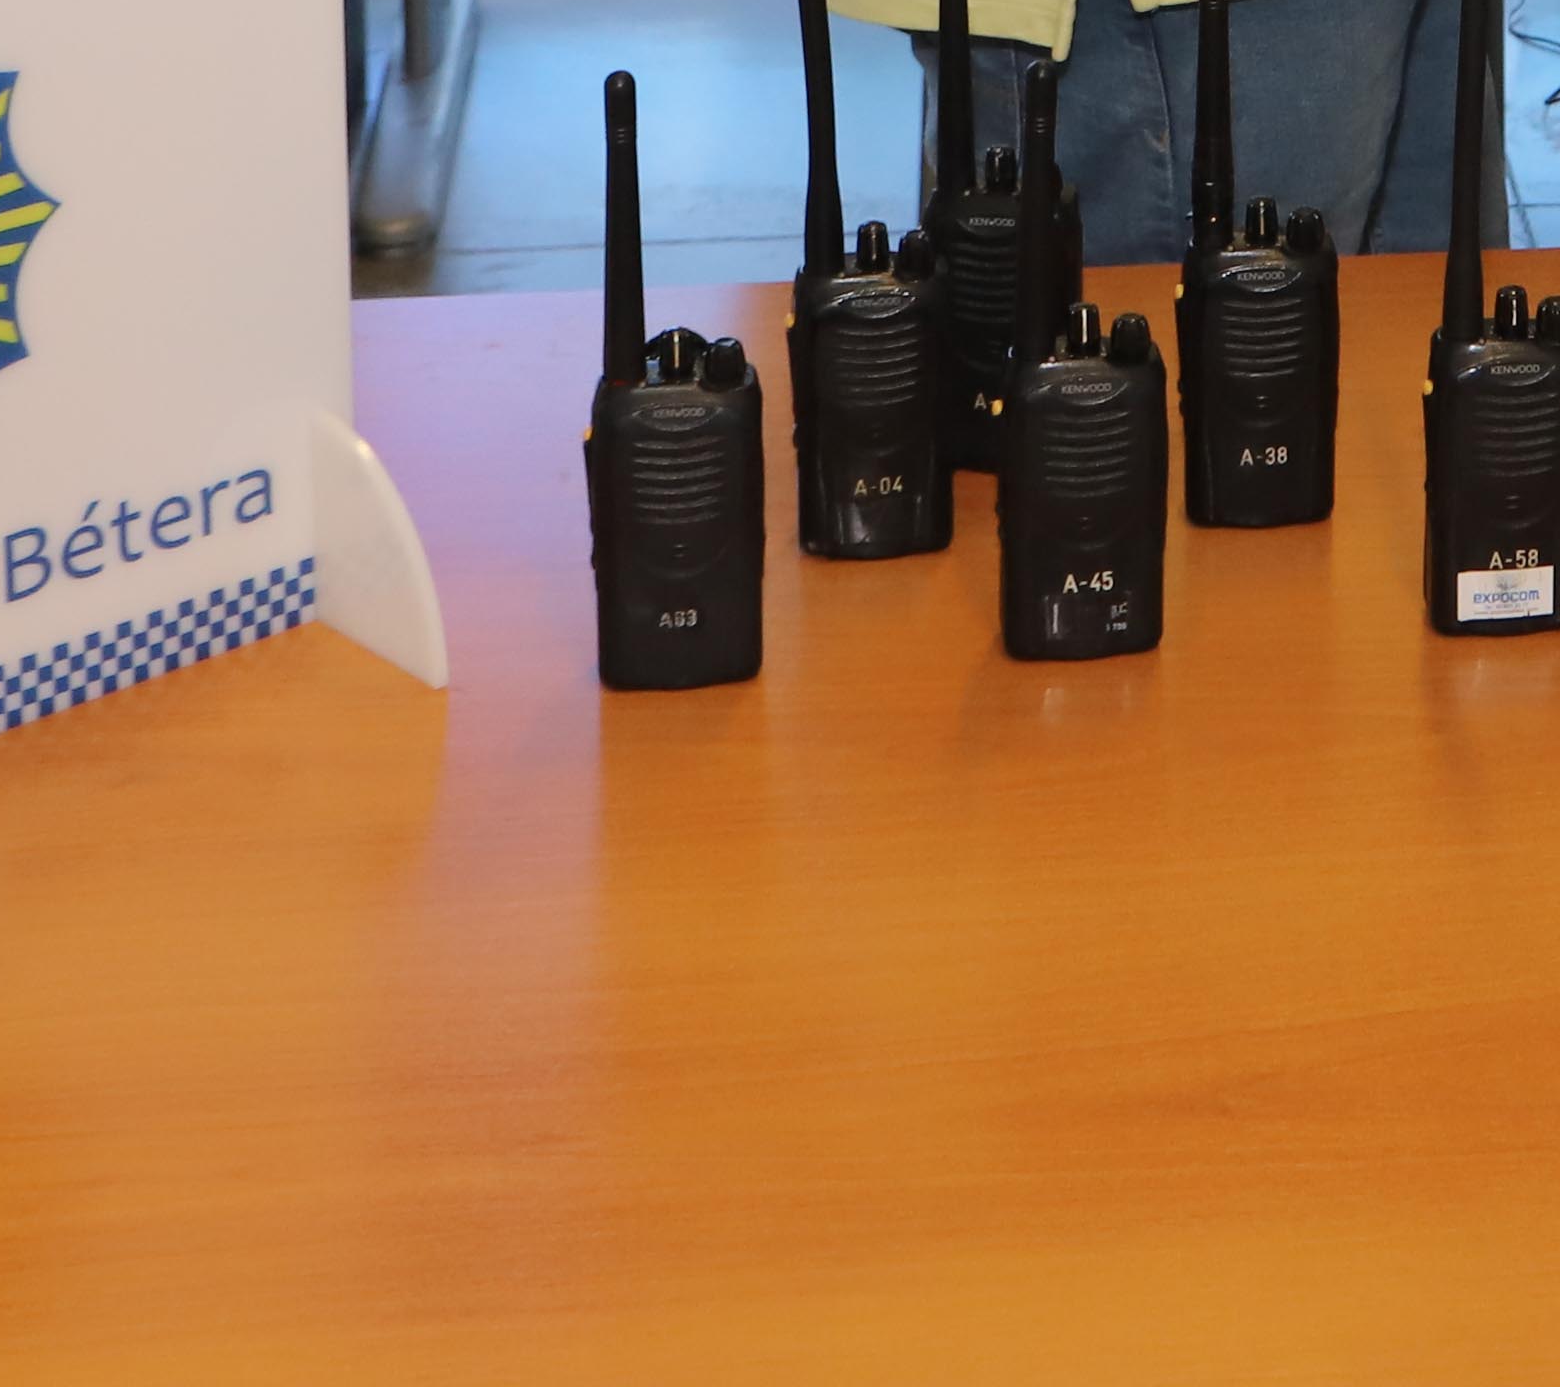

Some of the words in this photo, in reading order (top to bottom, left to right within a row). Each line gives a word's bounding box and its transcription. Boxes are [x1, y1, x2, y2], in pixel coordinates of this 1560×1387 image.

[969, 217, 1016, 228] KENWOOD
[1238, 271, 1286, 282] KENWOOD
[851, 296, 902, 308] KENWOOD
[1490, 363, 1541, 375] KENWOOD
[1061, 382, 1112, 394] KENWOOD
[652, 407, 707, 419] KENWOOD
[1240, 446, 1288, 467] A-38
[854, 475, 903, 496] A-04
[3, 469, 274, 603] Bétera
[1489, 548, 1539, 570] A-58
[1062, 571, 1114, 594] A-45
